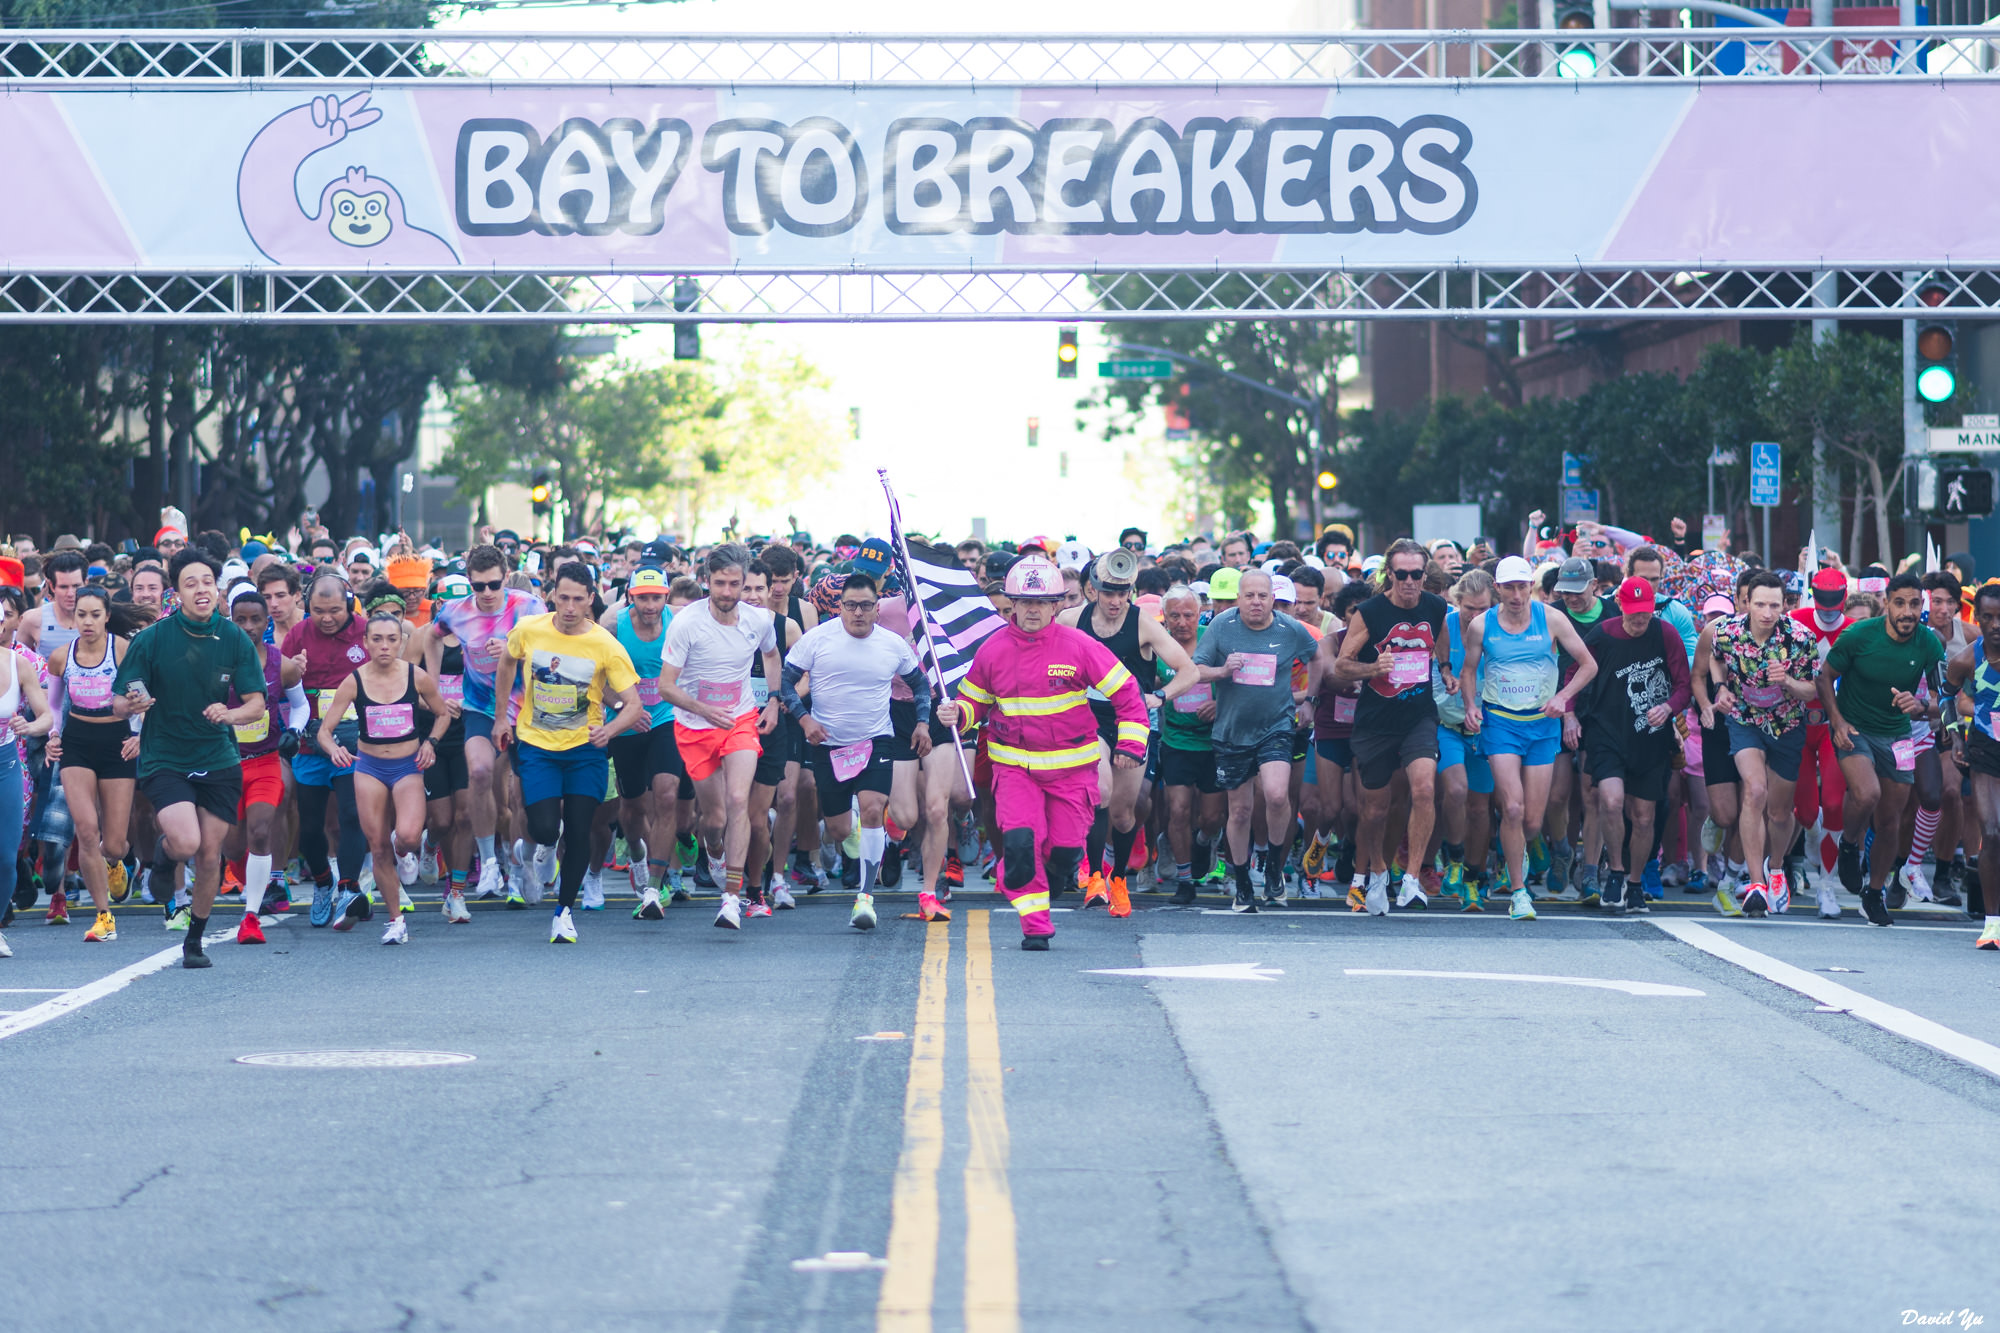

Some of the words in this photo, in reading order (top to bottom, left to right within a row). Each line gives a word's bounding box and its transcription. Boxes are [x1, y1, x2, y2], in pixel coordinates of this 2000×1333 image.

[461, 120, 686, 233] BAY
[707, 120, 861, 233] TO
[888, 118, 1472, 234] BREAKERS
[1957, 432, 2000, 446] MAIN
[861, 547, 884, 562] FBI
[1501, 685, 1536, 694] A10007
[535, 693, 575, 705] A50030
